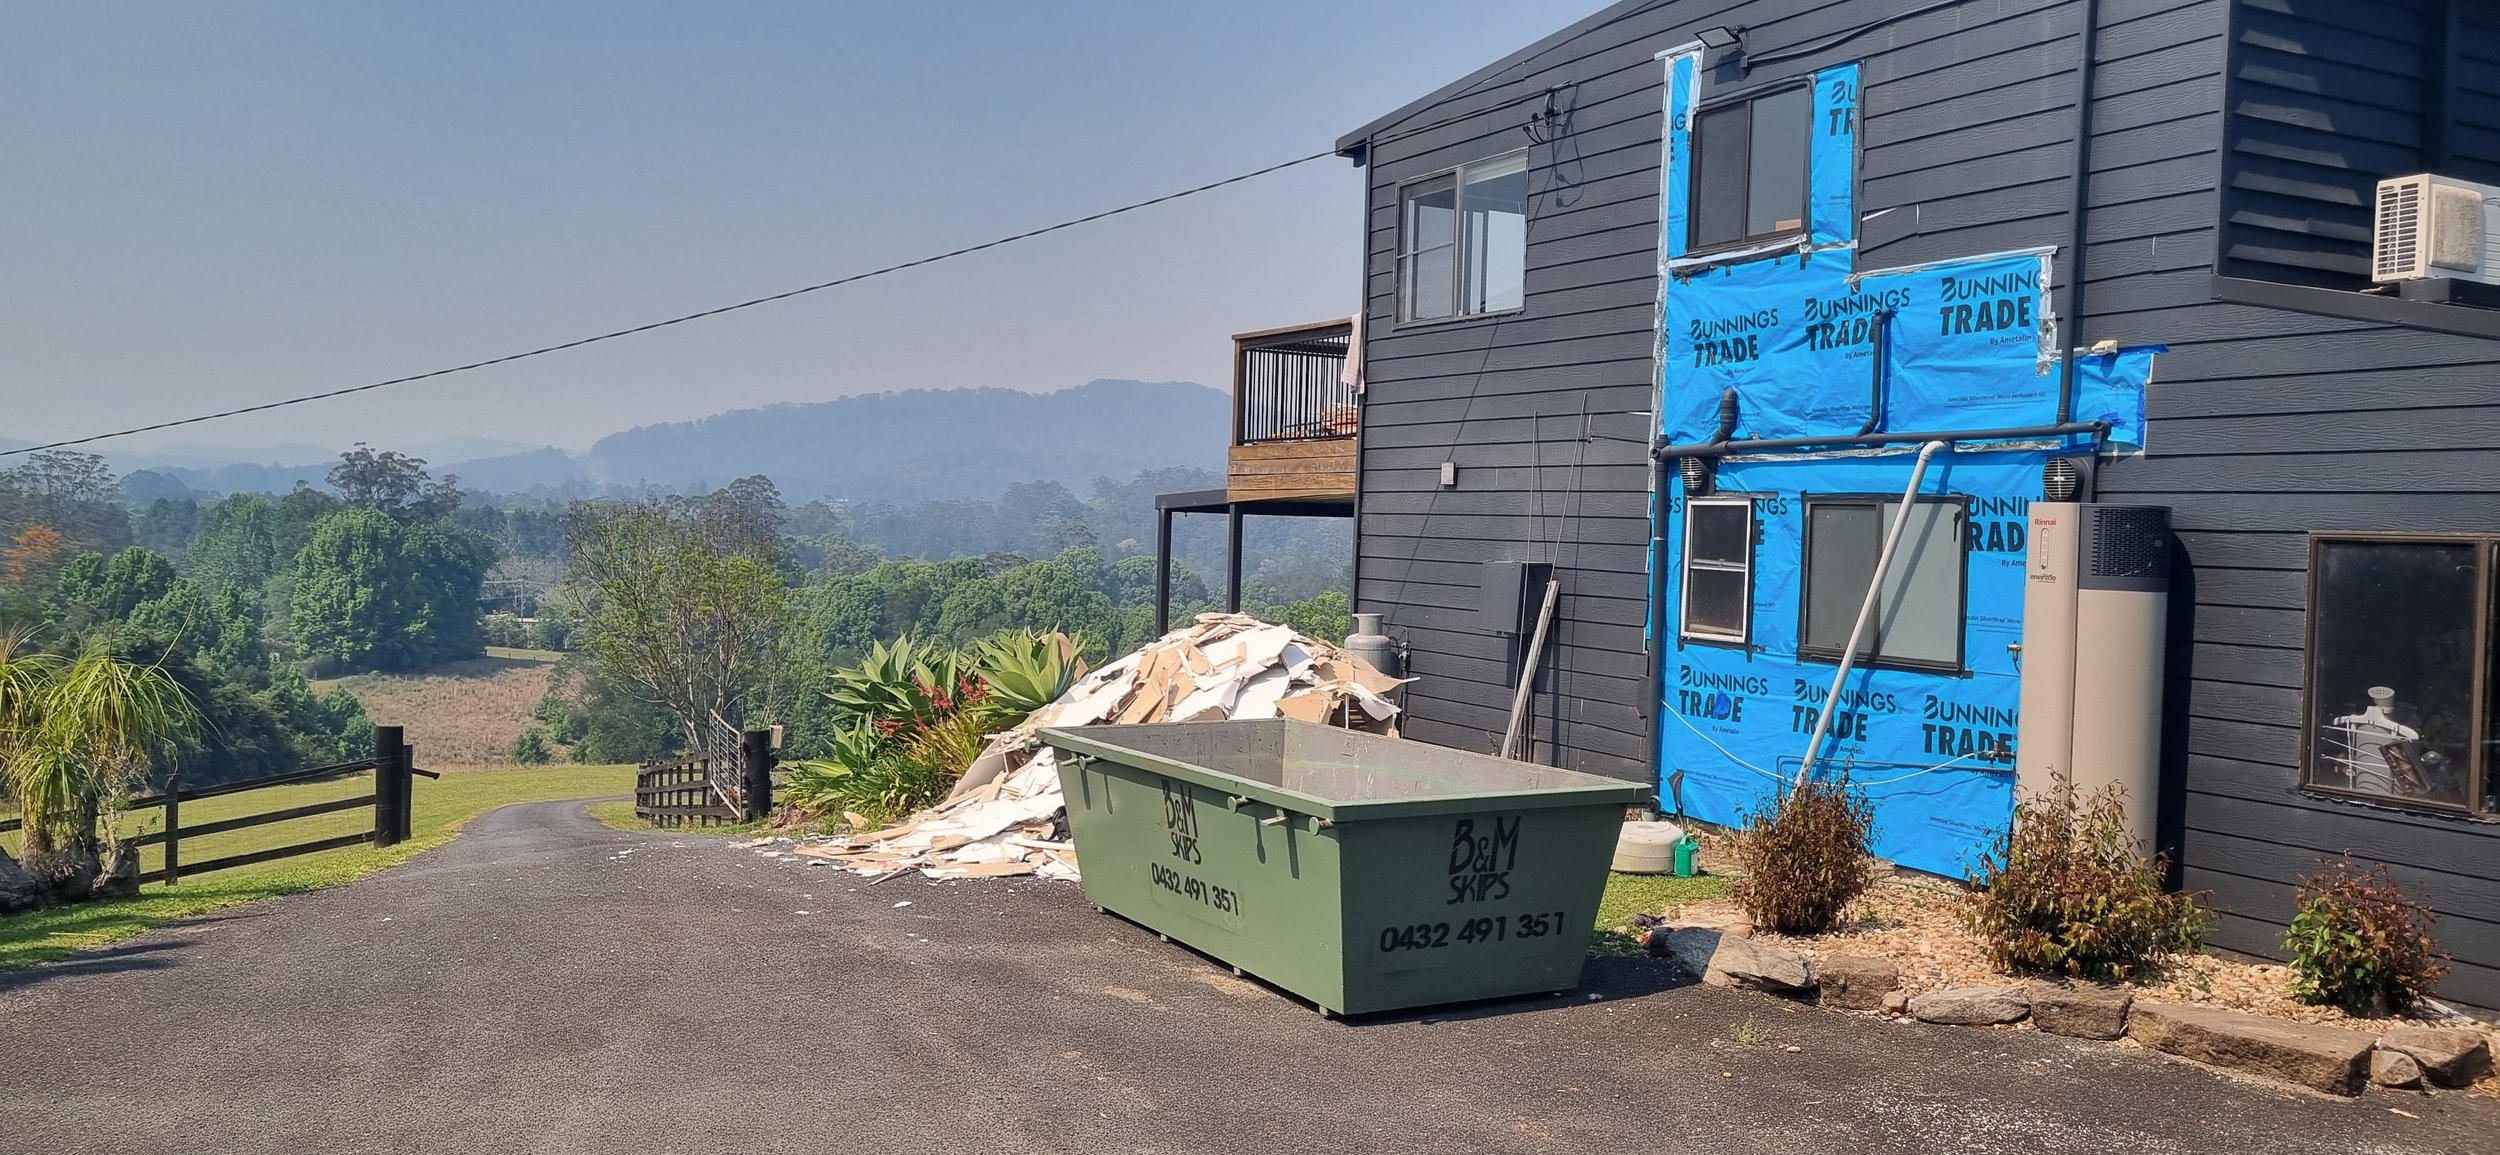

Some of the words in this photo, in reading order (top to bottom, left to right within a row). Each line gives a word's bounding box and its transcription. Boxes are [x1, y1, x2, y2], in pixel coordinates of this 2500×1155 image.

[1805, 287, 1911, 321] BUNNINGS
[1940, 296, 2031, 336] TRADE
[1691, 308, 1779, 340] BUNNINGS
[1694, 334, 1759, 368] TRADE
[1989, 337, 1999, 346] By
[2034, 518, 2057, 526] Rinnai
[2001, 559, 2010, 568] By
[1680, 665, 1768, 696] BUNNINGS
[1794, 679, 1896, 713] BUNNINGS
[1792, 705, 1868, 742] TRADE
[1924, 694, 2019, 728] BUNNIN
[1922, 723, 2013, 764] TRADE
[1161, 779, 1198, 838] B&M
[1170, 832, 1202, 865] SKIPS
[1448, 816, 1521, 875] B&M
[1151, 862, 1182, 895] 0432
[1184, 876, 1208, 905] 491
[1212, 885, 1239, 916] 351
[1446, 871, 1510, 905] SKIPS
[1379, 922, 1450, 952] 0432
[1456, 916, 1507, 944] 491
[1516, 911, 1564, 939] 351
